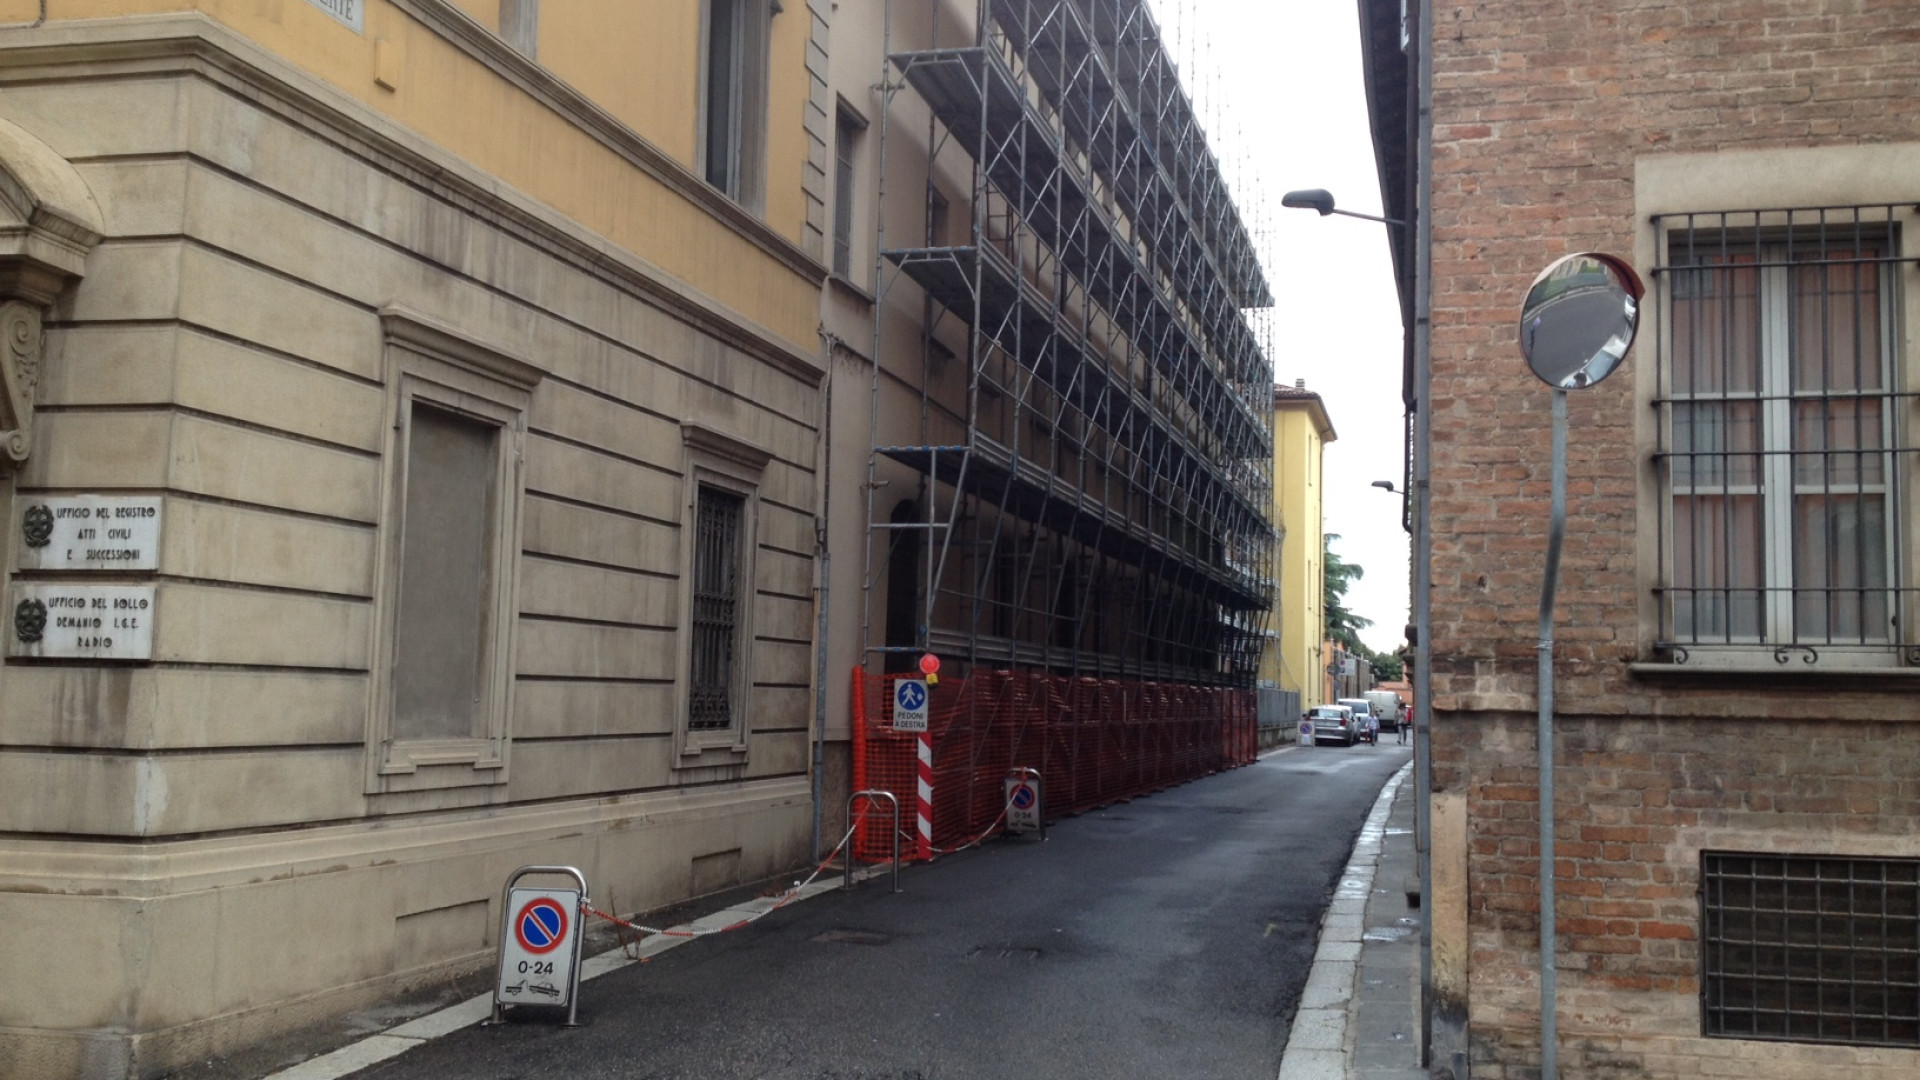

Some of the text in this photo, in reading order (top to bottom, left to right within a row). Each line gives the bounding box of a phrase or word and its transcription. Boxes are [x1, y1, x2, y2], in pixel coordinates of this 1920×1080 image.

[56, 506, 156, 519] UFFICIO DEL REGISTRO
[77, 528, 131, 540] ATTI CIVILI
[66, 549, 140, 560] E SUCCESSIONI
[49, 597, 149, 610] UFFICIO DEL BOLLO
[56, 616, 102, 628] DEMANIO
[77, 636, 113, 648] RADIO
[897, 711, 924, 720] PEDONI
[894, 720, 926, 728] A DESTRA
[518, 960, 554, 975] 0-24
